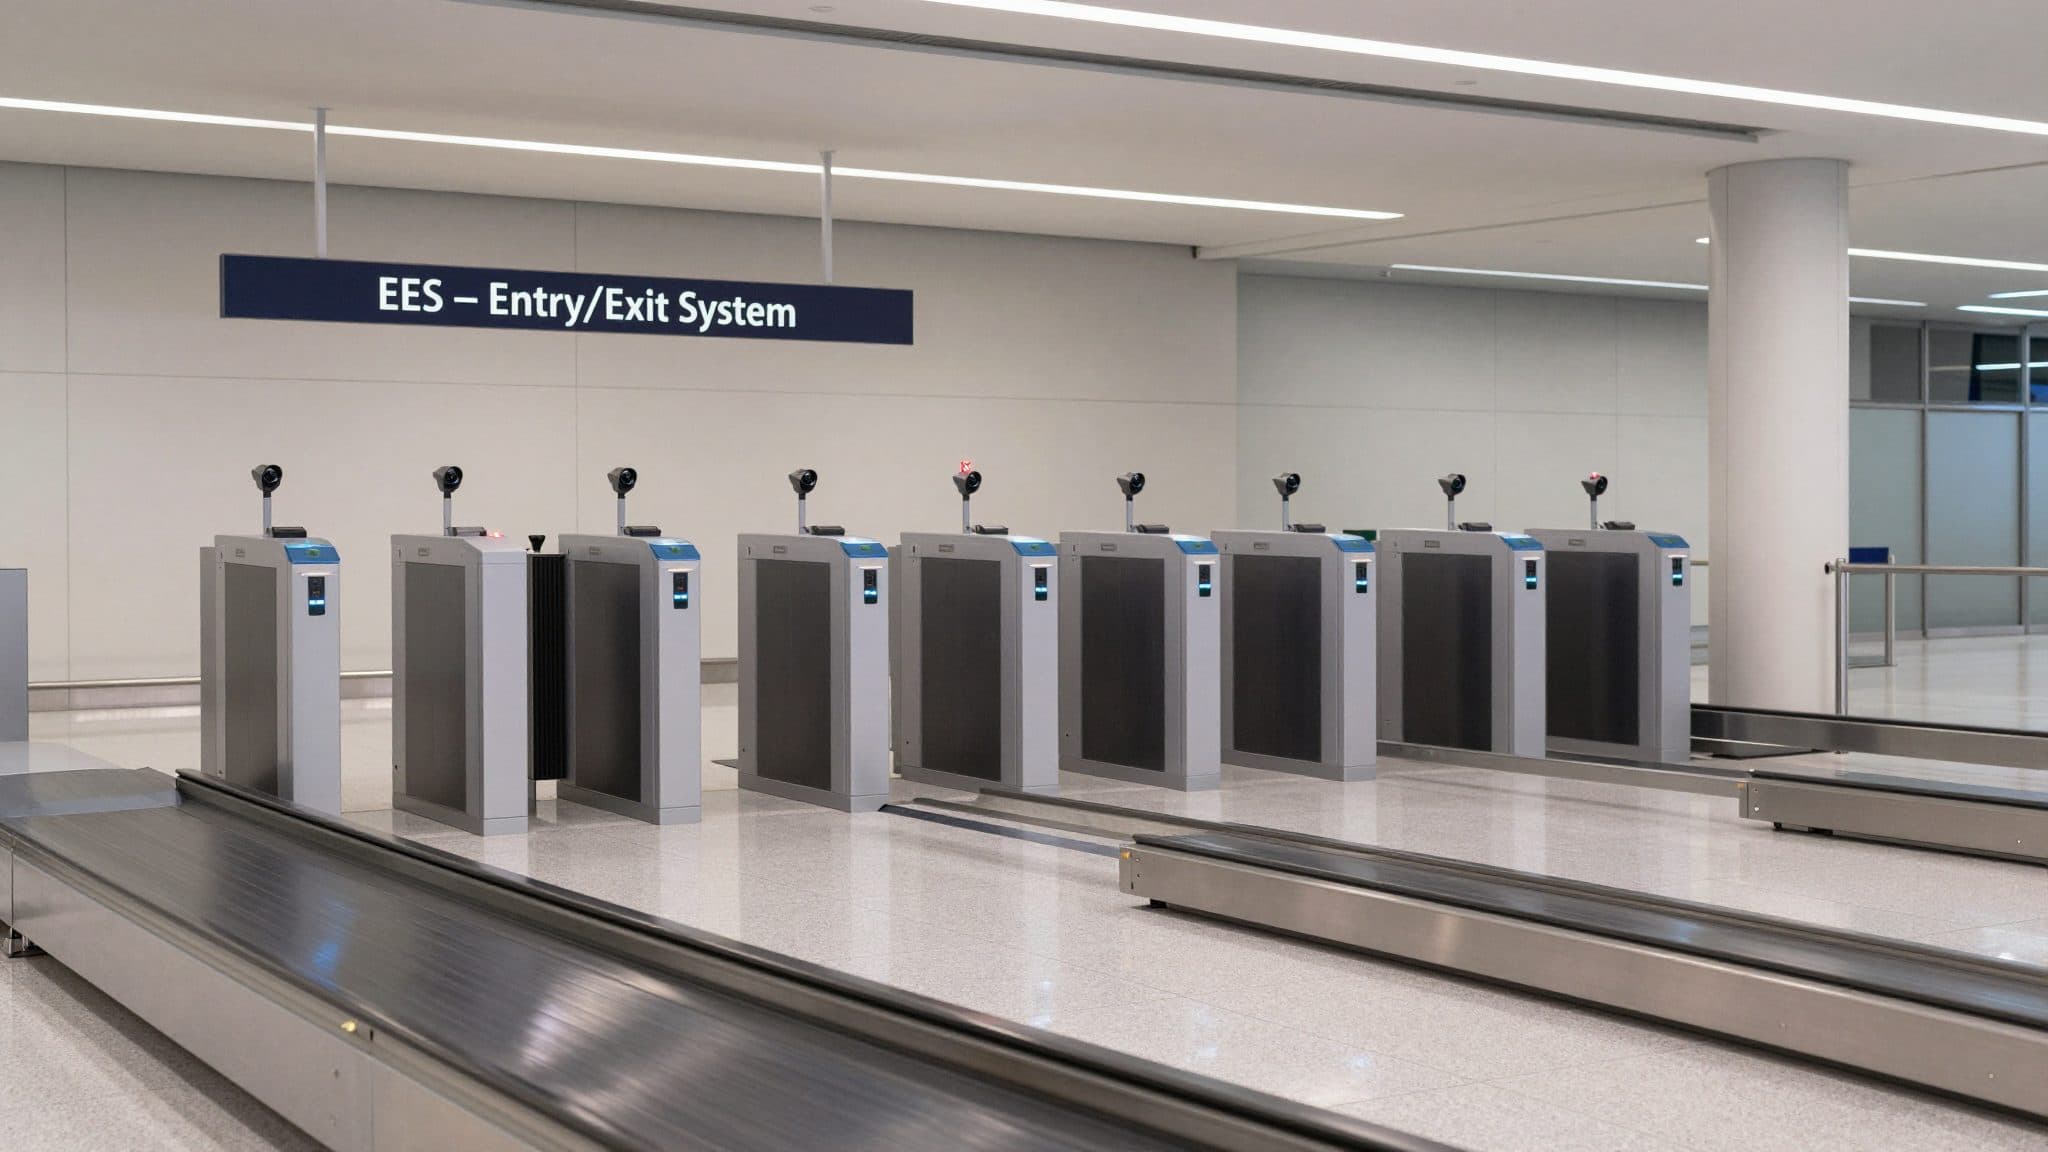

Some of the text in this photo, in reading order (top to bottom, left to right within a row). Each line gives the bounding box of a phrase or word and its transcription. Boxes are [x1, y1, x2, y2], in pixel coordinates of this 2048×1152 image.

[378, 276, 444, 314] EES
[489, 282, 671, 327] Entry/Exit
[678, 290, 796, 333] System
